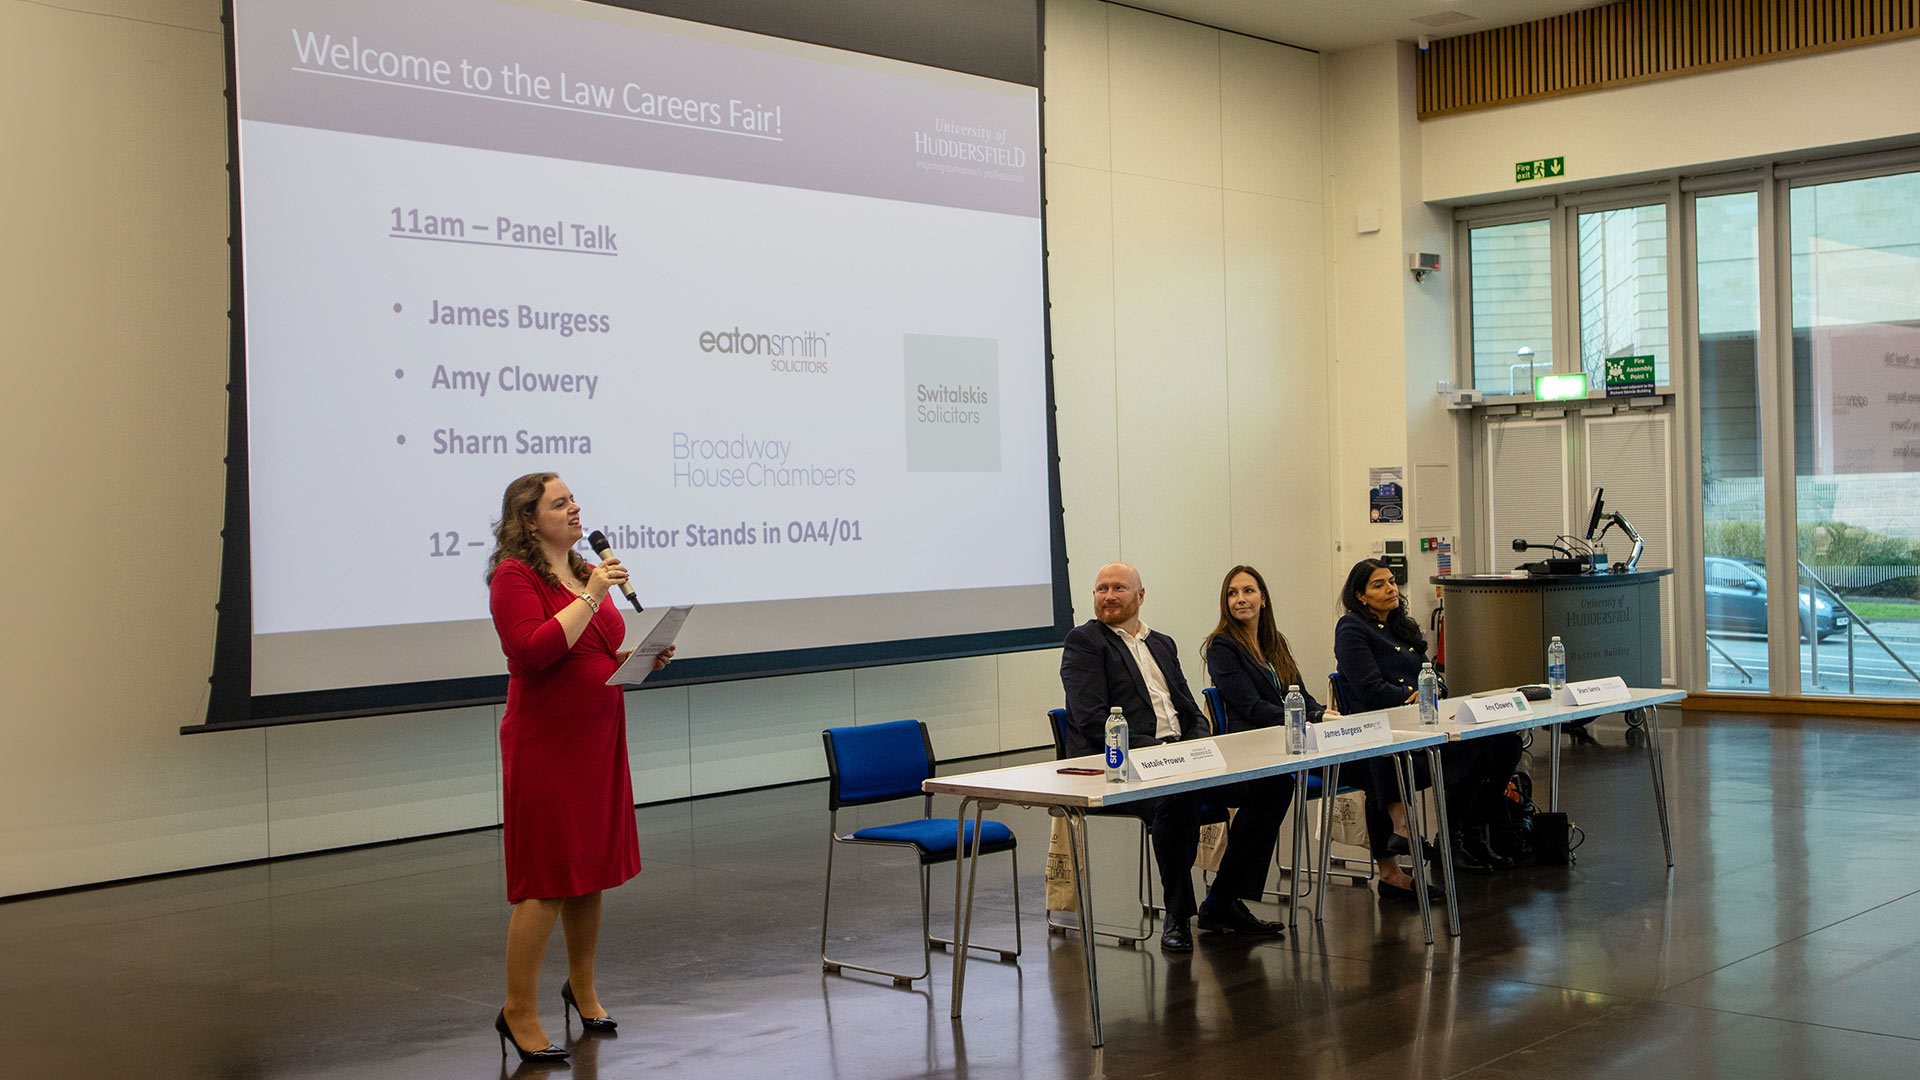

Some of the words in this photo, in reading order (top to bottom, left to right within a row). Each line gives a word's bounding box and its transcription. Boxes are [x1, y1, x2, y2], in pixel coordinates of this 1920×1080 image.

[291, 28, 451, 86] Welcome
[460, 59, 493, 91] to
[501, 62, 551, 100] the
[560, 72, 615, 109] Law
[623, 83, 721, 126] Careers
[729, 99, 782, 134] Fair!
[935, 117, 992, 144] University
[995, 128, 1008, 146] of
[914, 131, 1026, 168] HUDDERSFIELD
[1516, 164, 1531, 172] Fire
[1516, 172, 1531, 180] exit
[390, 206, 465, 237] 11am
[496, 216, 564, 246] Panel
[570, 221, 618, 251] Talk
[429, 300, 510, 328] James
[518, 305, 610, 338] Burgess
[771, 358, 828, 374] SOLICITORS
[431, 364, 491, 397] Amy
[498, 366, 599, 399] Clowery
[916, 383, 988, 405] Switalskis
[917, 404, 981, 424] Solicitors
[433, 428, 508, 455] Sharn
[515, 429, 592, 455] Samra
[672, 432, 792, 466] Broadway
[672, 461, 857, 488] HouseChambers
[429, 531, 461, 557] 12
[577, 521, 679, 551] Ehibitor
[685, 521, 757, 547] Stands
[763, 521, 781, 544] in
[787, 517, 863, 546] OA4/01
[1567, 607, 1632, 627] HUDDERSFIELD
[1323, 730, 1341, 739] James
[1340, 727, 1363, 736] Burgess
[1141, 758, 1164, 769] Natalie
[1162, 755, 1186, 766] Prowse
